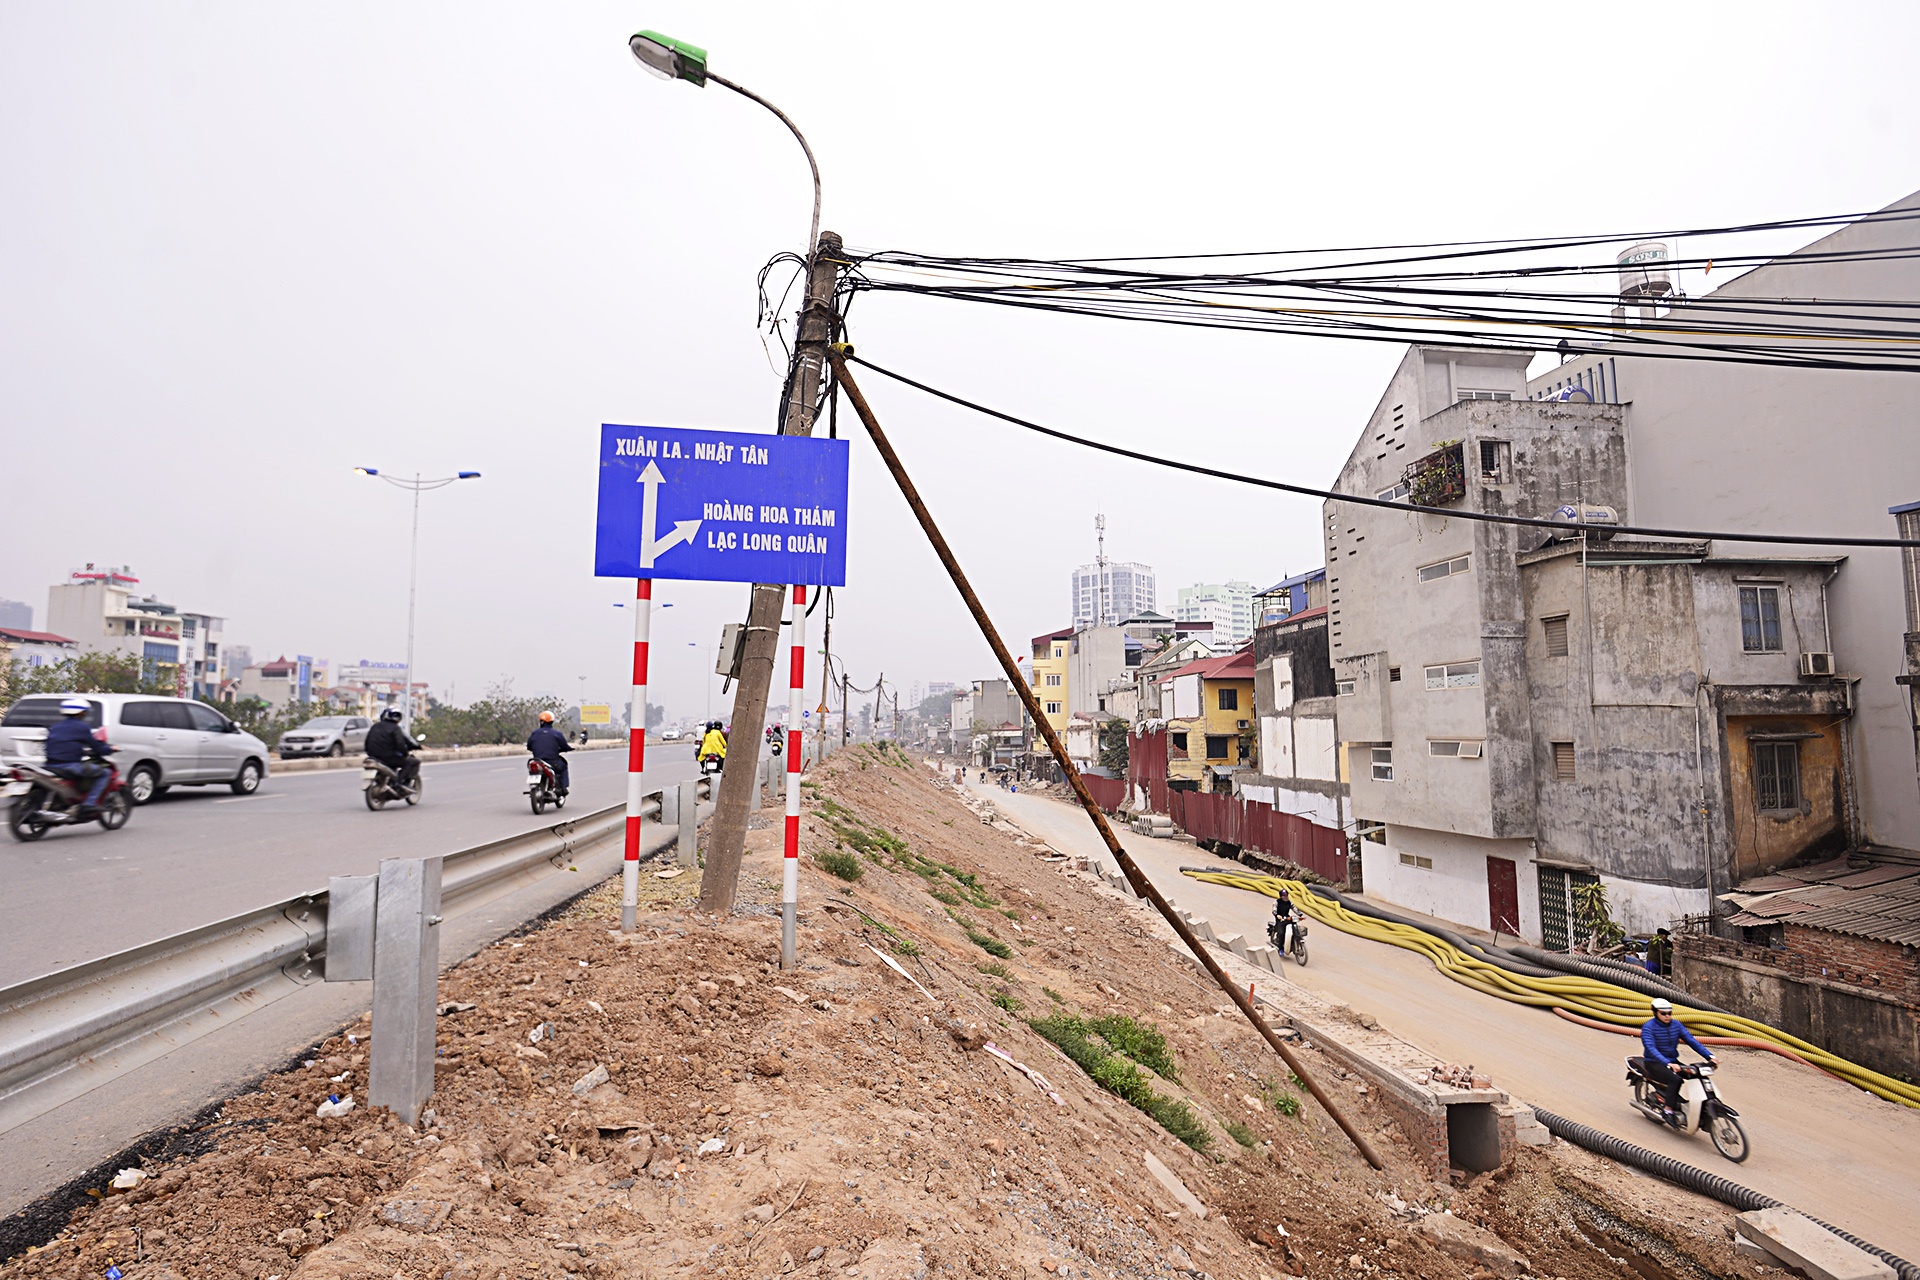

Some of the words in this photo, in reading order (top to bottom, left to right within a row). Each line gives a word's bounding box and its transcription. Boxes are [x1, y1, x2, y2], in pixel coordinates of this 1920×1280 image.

[615, 436, 658, 458] XUÂN
[662, 441, 682, 459] LA
[694, 441, 734, 465] NHẬT
[740, 444, 769, 466] TÂN
[703, 499, 754, 523] HOÀNG
[759, 506, 790, 524] HOA
[793, 504, 836, 527] THÁM
[707, 531, 737, 553] LẠC
[742, 532, 782, 552] LONG
[787, 533, 828, 555] QUÂN
